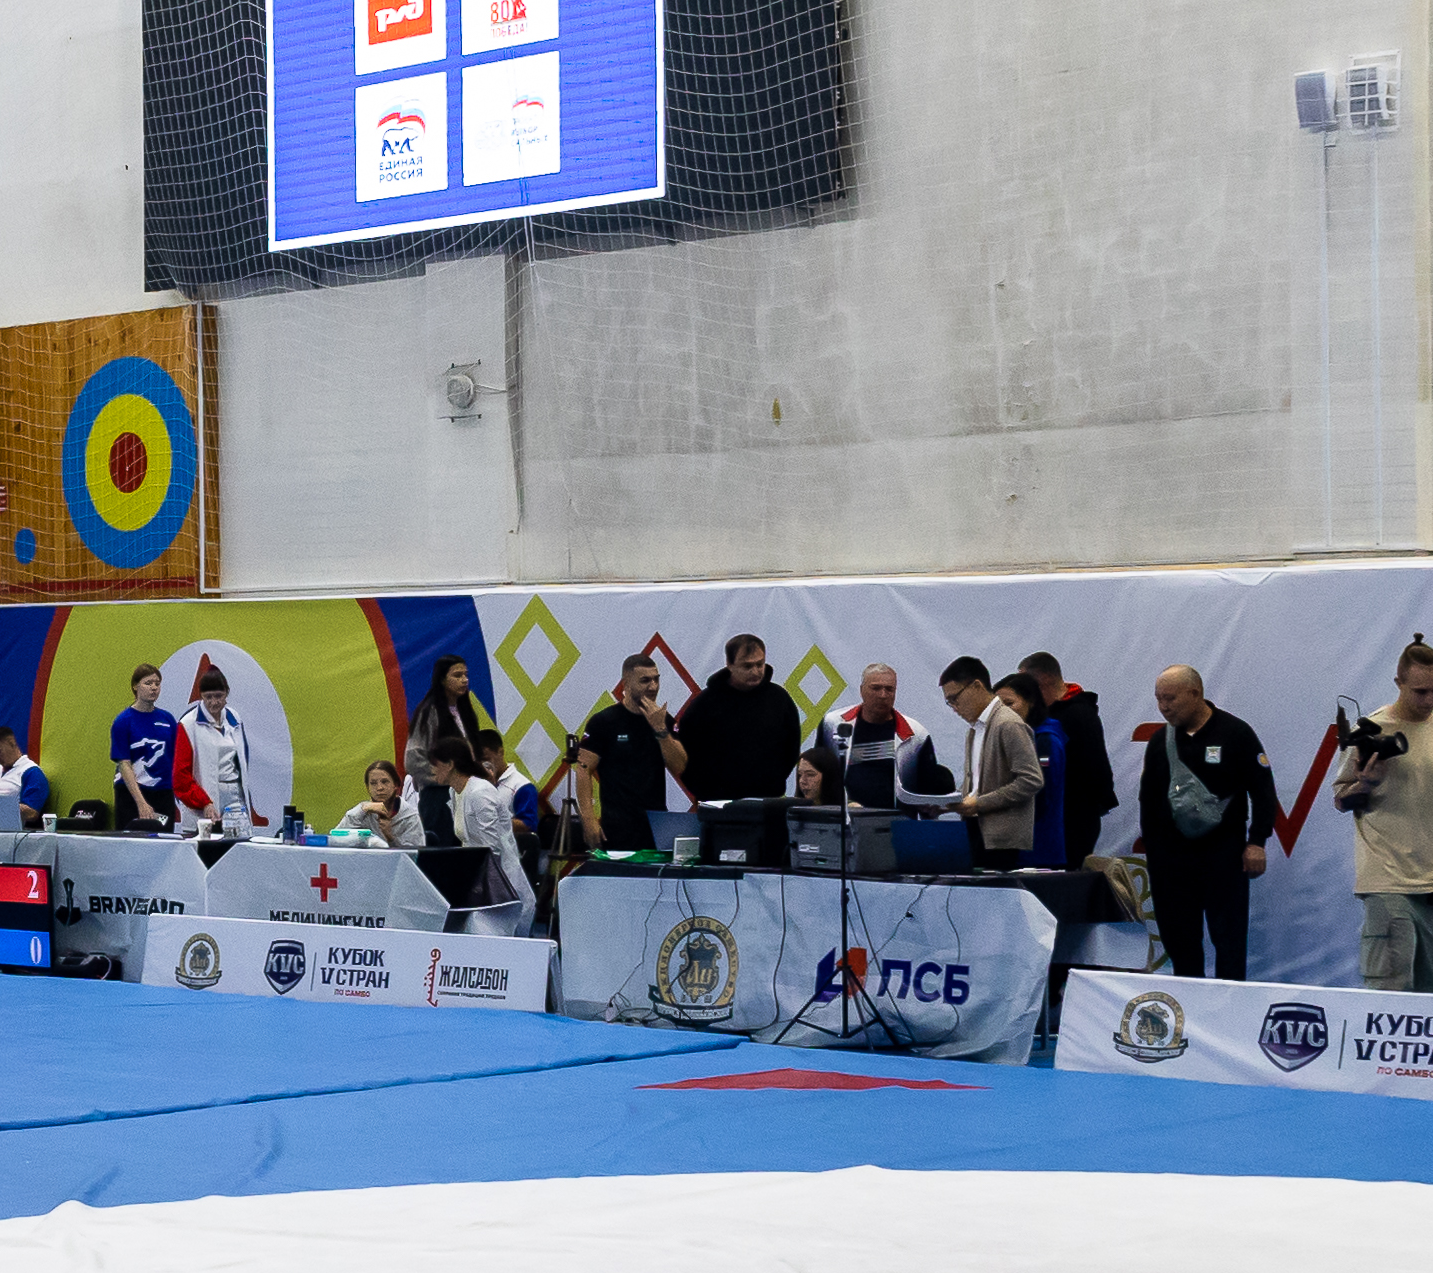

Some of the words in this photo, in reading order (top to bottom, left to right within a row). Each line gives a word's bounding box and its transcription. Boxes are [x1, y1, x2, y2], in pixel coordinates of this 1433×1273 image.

[379, 156, 423, 171] ЕДИНАЯ
[379, 168, 423, 183] РОССИЯ
[27, 870, 39, 899] 2
[30, 936, 42, 965] 0
[328, 947, 386, 968] КУБОК
[265, 952, 306, 974] KVC
[321, 967, 335, 985] V
[335, 969, 391, 989] СТРАН
[877, 959, 970, 1005] ПСБ
[1261, 1018, 1327, 1048] KVC
[1354, 1038, 1378, 1061] V
